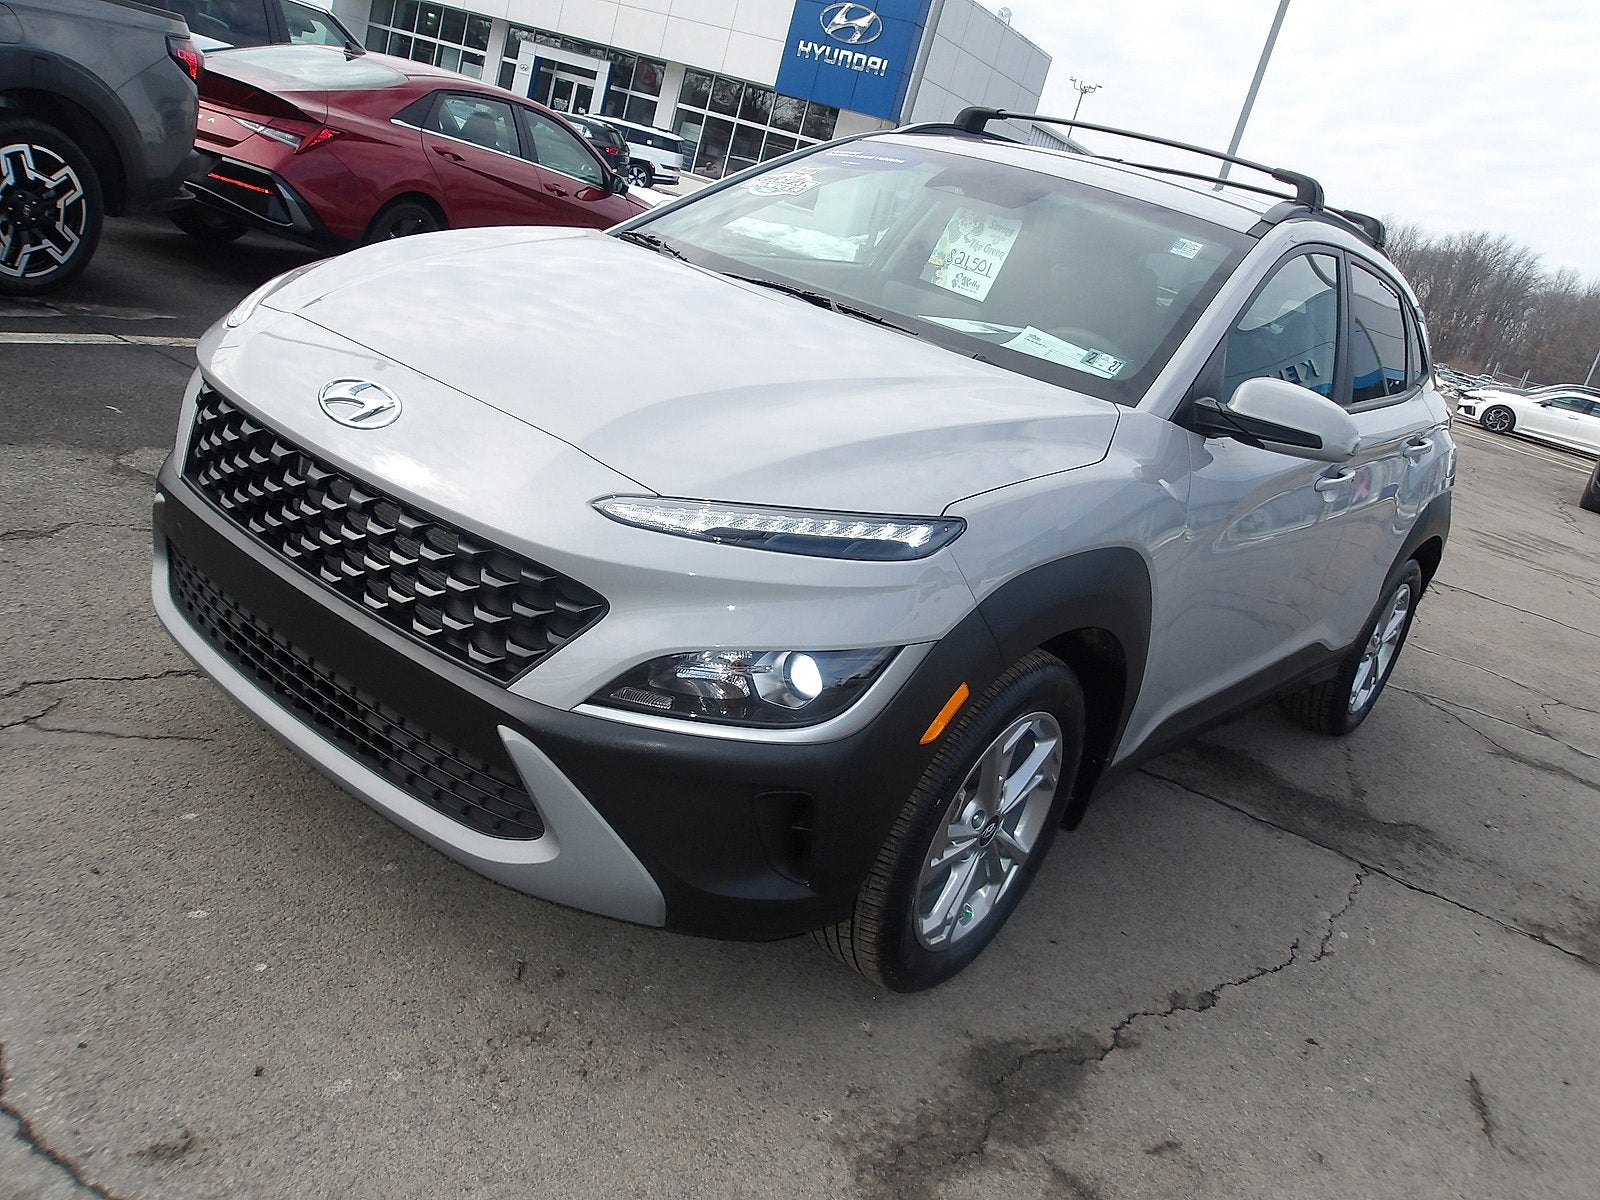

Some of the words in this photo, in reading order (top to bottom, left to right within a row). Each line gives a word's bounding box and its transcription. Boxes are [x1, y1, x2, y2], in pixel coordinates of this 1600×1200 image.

[797, 40, 888, 77] HYUNDAI
[983, 243, 1005, 261] Green
[1086, 352, 1098, 364] 2
[1108, 361, 1122, 372] 27
